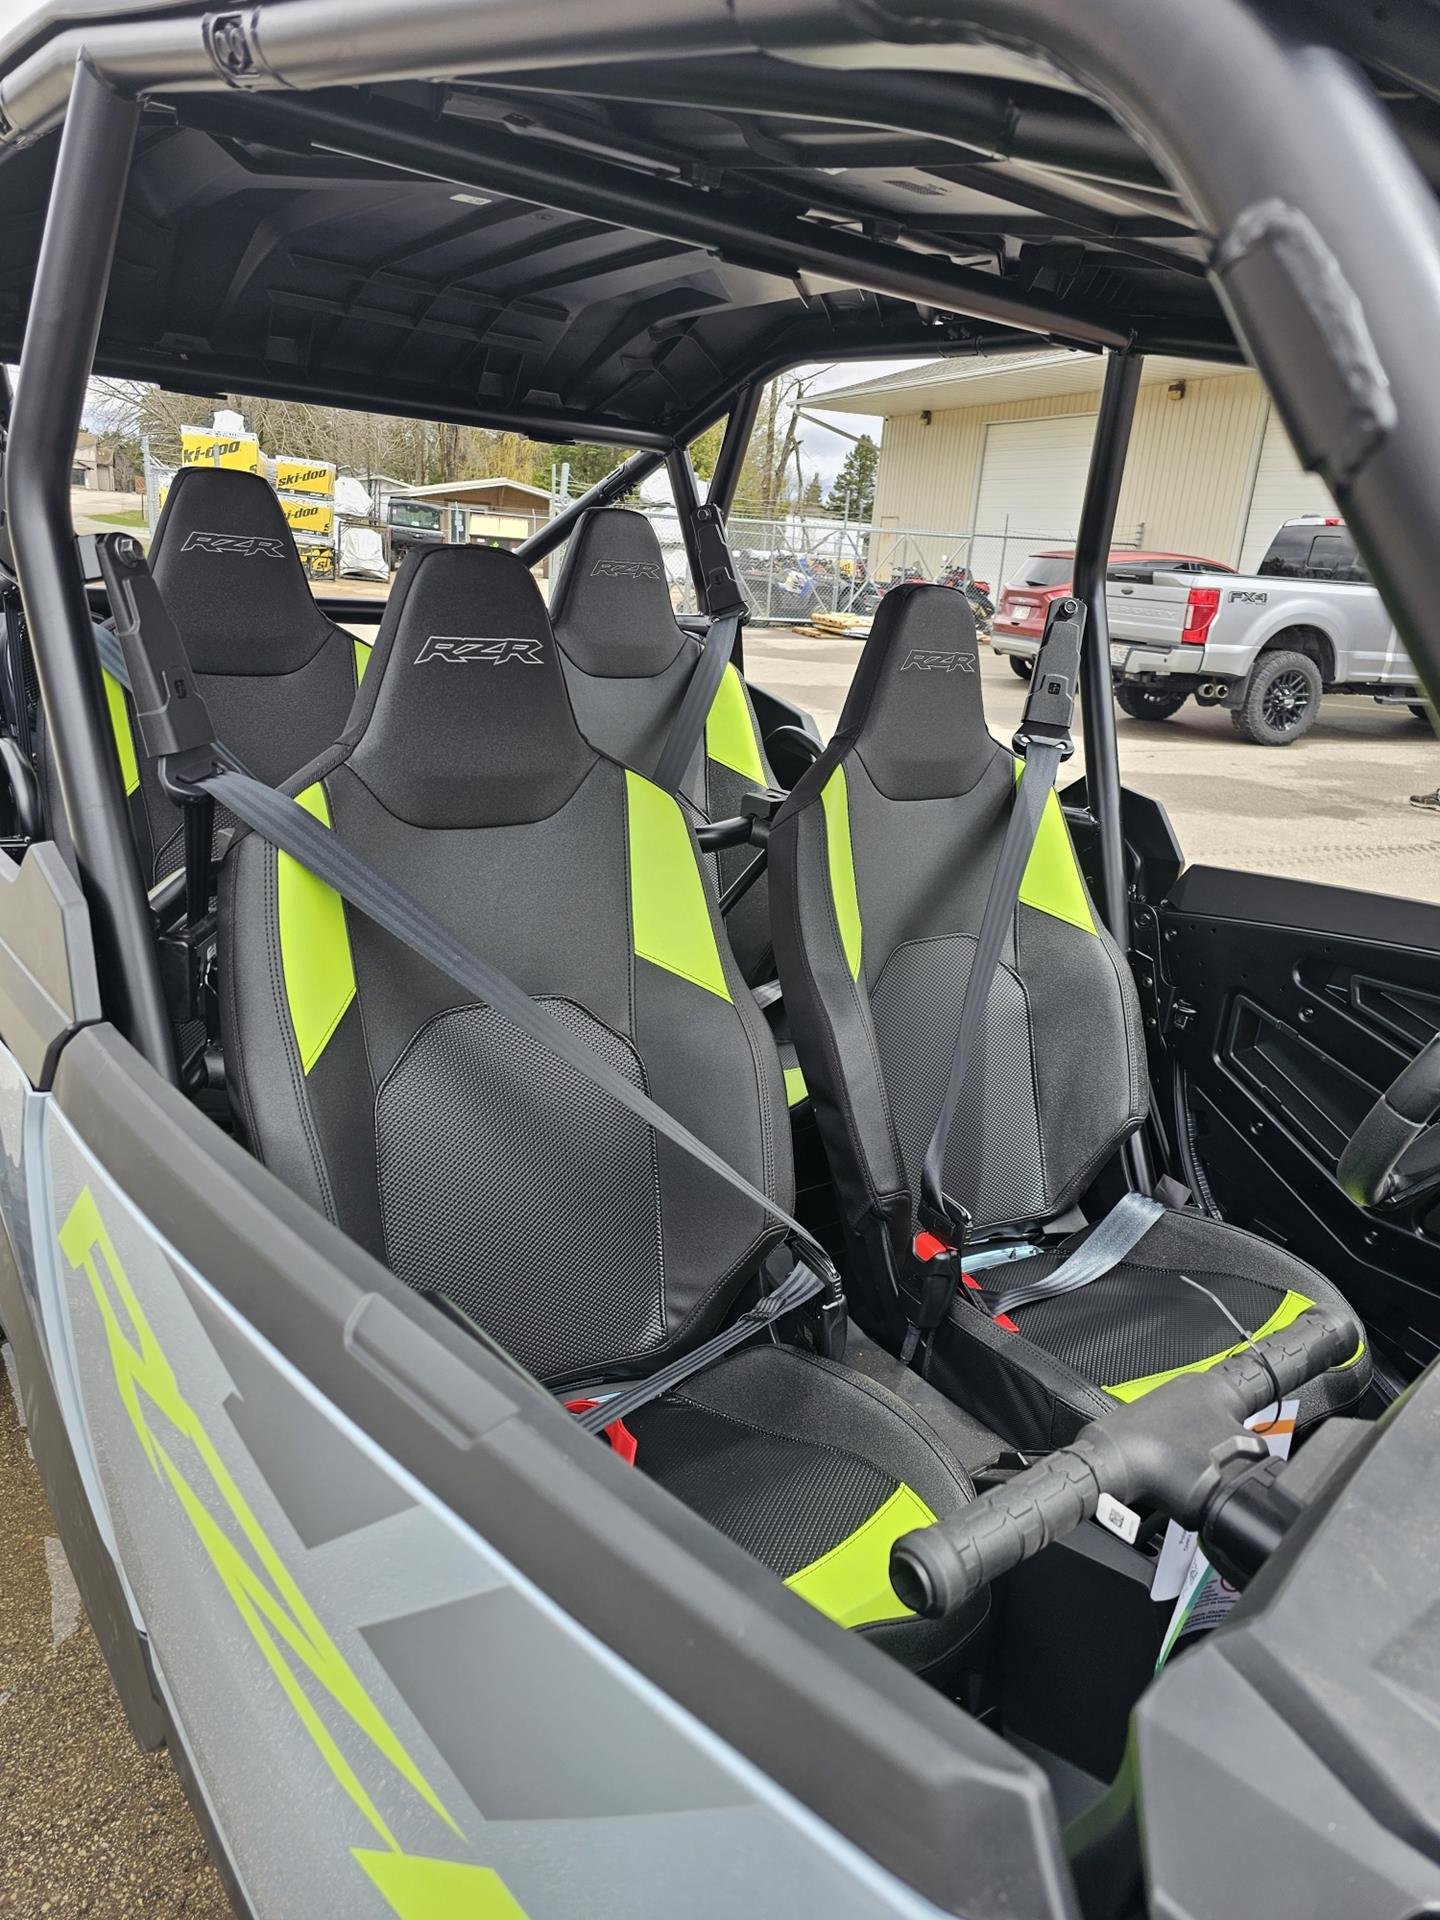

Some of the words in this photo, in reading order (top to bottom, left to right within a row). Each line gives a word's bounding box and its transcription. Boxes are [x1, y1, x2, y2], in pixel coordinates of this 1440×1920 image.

[183, 441, 240, 463] ki-doo
[278, 469, 327, 487] ski-doo
[283, 506, 319, 520] i-doo
[181, 532, 285, 557] RZR
[591, 560, 660, 579] RZR
[1228, 591, 1268, 603] FX4
[414, 636, 544, 665] RZR
[902, 650, 975, 672] RZR
